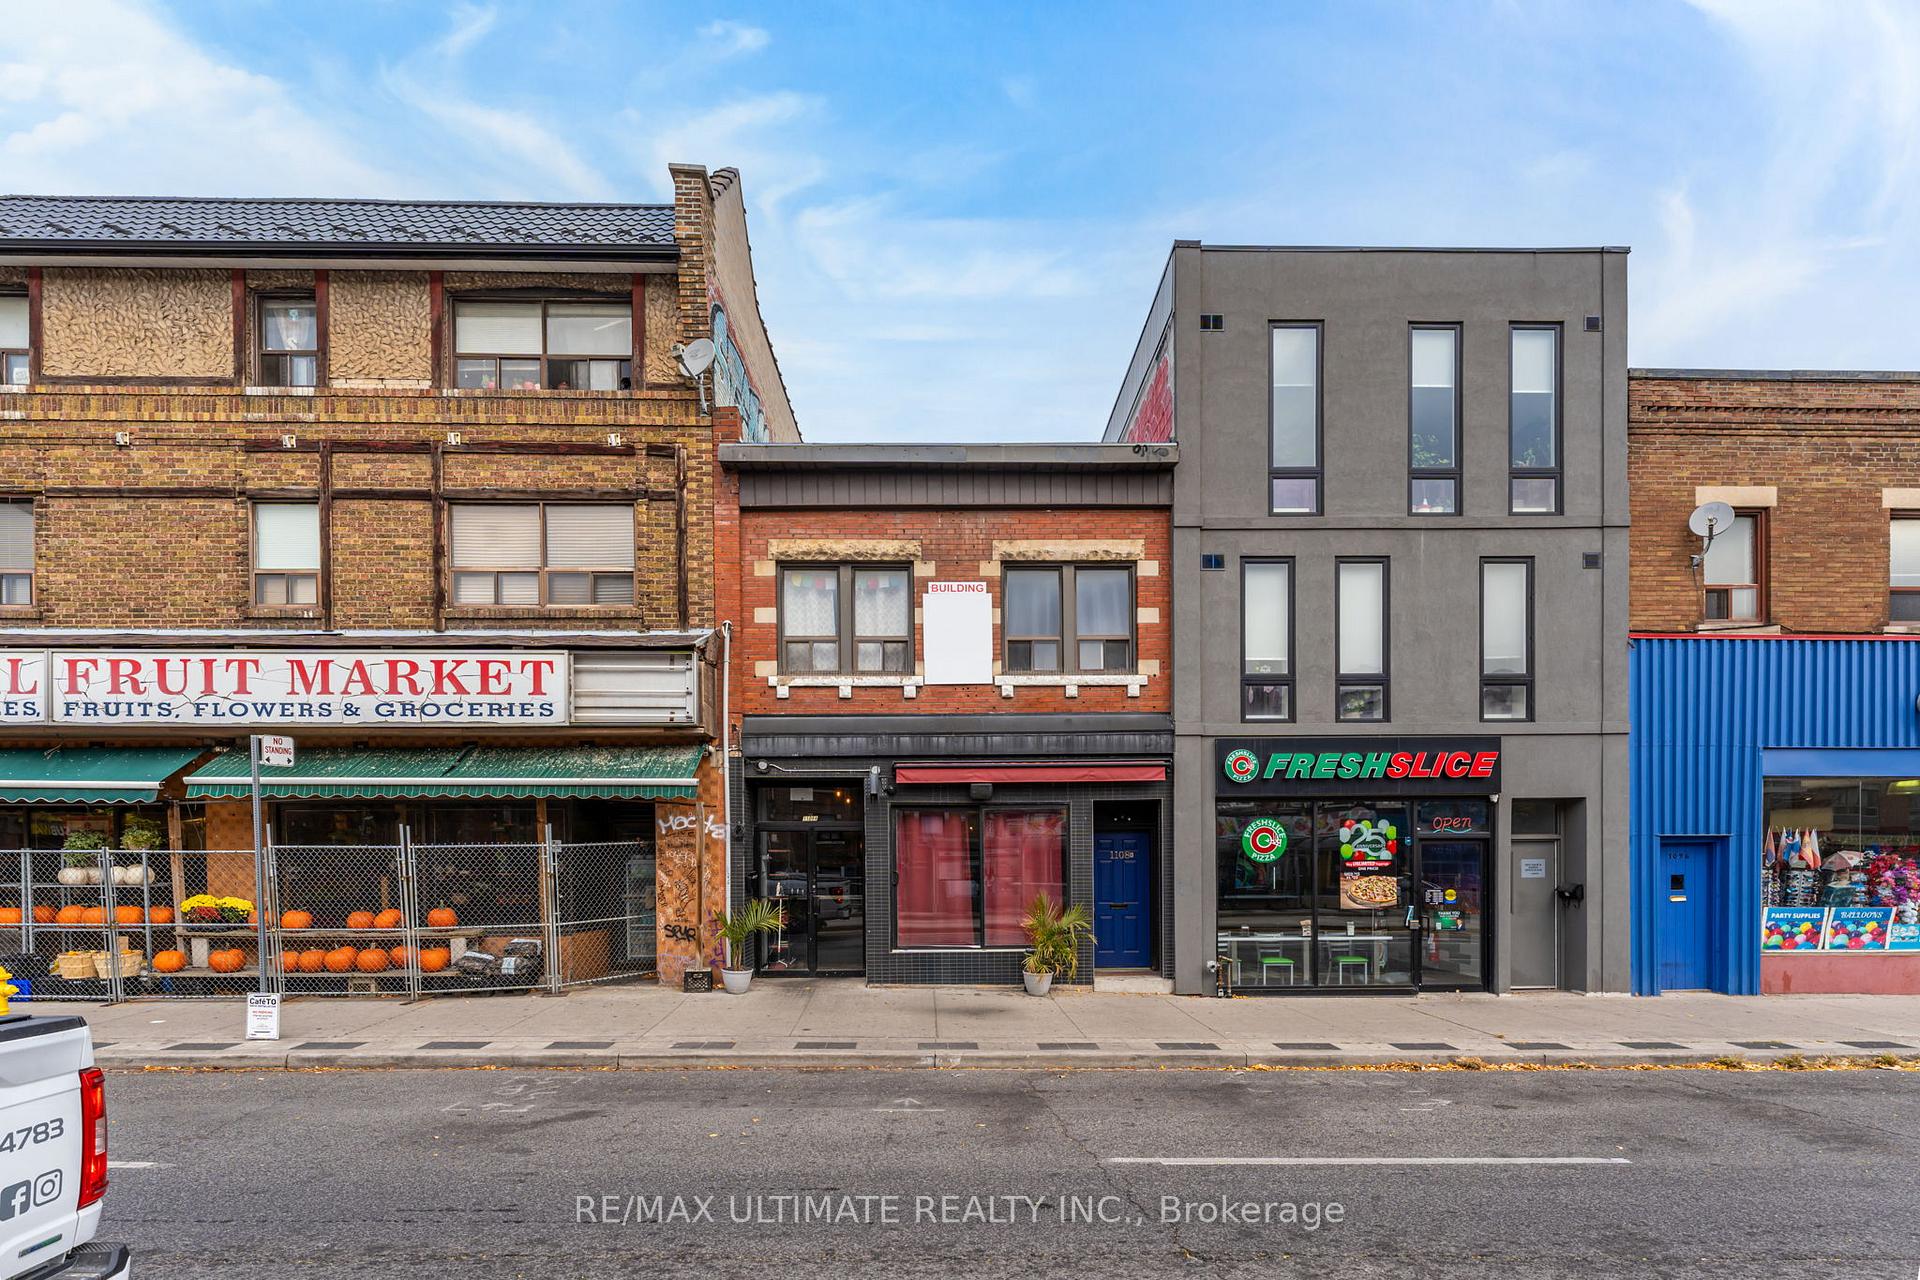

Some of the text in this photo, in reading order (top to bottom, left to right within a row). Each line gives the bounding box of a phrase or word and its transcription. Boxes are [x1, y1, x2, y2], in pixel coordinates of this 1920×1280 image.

[931, 583, 984, 593] BUILDING
[0, 658, 38, 695] L
[63, 658, 555, 696] FRUIT MARKET
[0, 701, 40, 717] ES,
[63, 702, 554, 719] FRUITS, FLOWERS & GROCERIES
[264, 745, 292, 755] STANDING
[272, 737, 283, 746] NO
[1263, 751, 1499, 779] FRESHSLICE
[1243, 819, 1287, 839] FRESHSLICE
[1350, 823, 1387, 857] 25
[1251, 852, 1276, 862] PIZZA
[1840, 911, 1884, 919] BALLOONS
[0, 1117, 64, 1153] 4783
